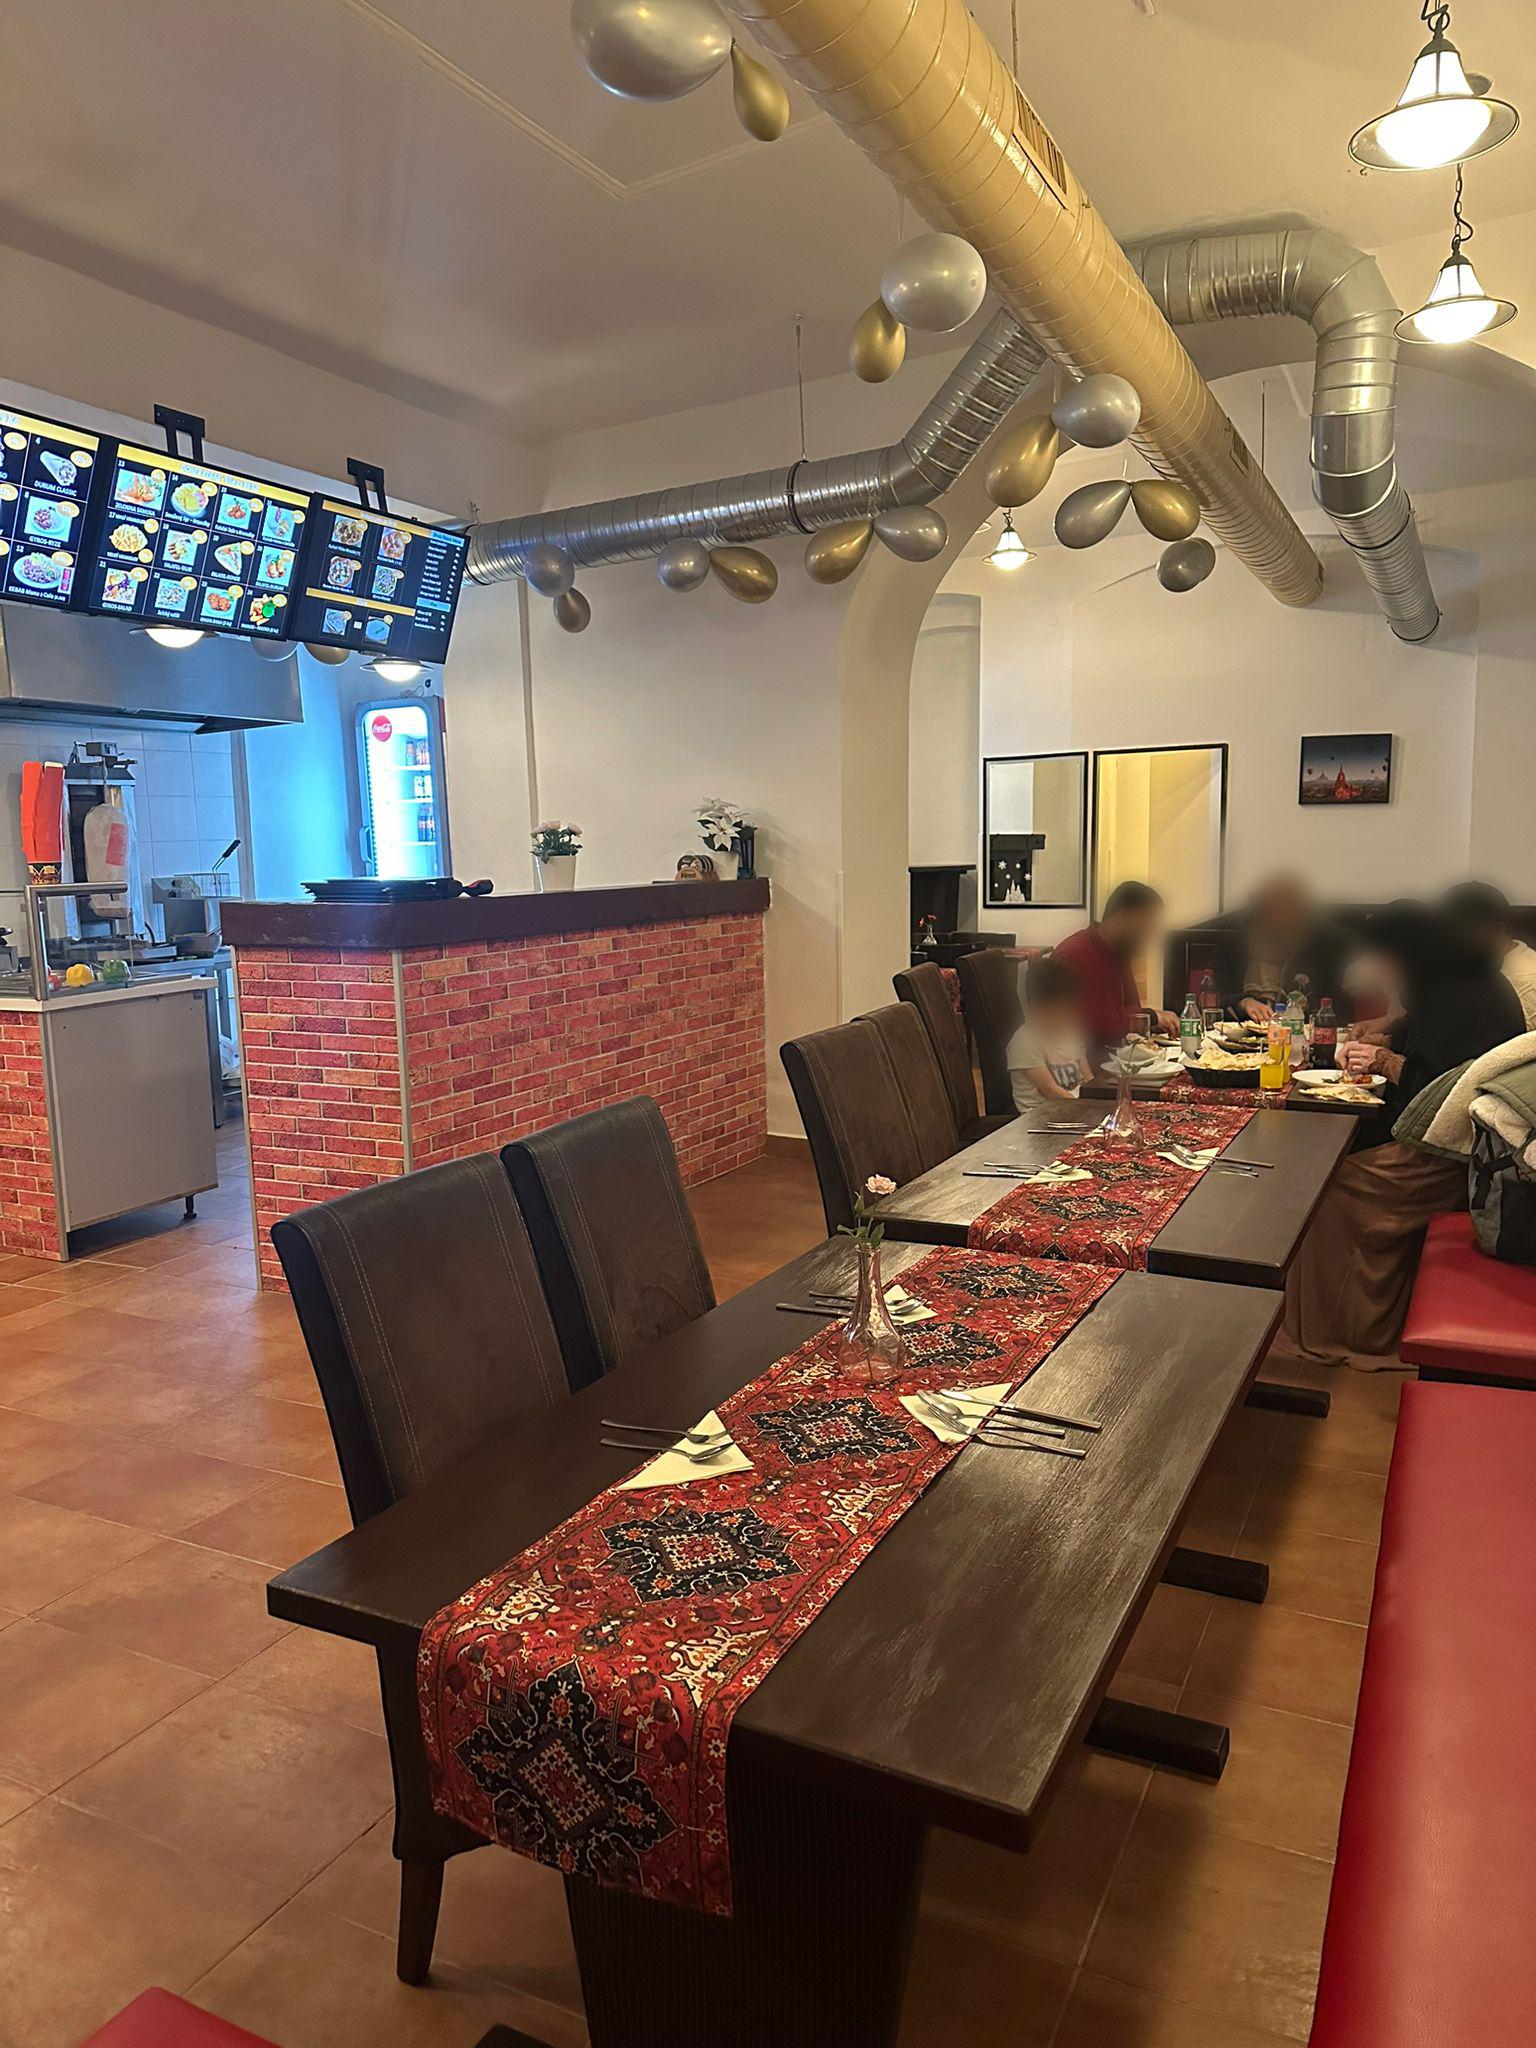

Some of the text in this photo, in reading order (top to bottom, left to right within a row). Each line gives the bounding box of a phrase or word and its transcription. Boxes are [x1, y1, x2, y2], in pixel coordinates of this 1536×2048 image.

[35, 436, 41, 445] 4
[56, 484, 77, 497] CLASSIC
[16, 545, 24, 553] 12
[99, 560, 106, 568] 21
